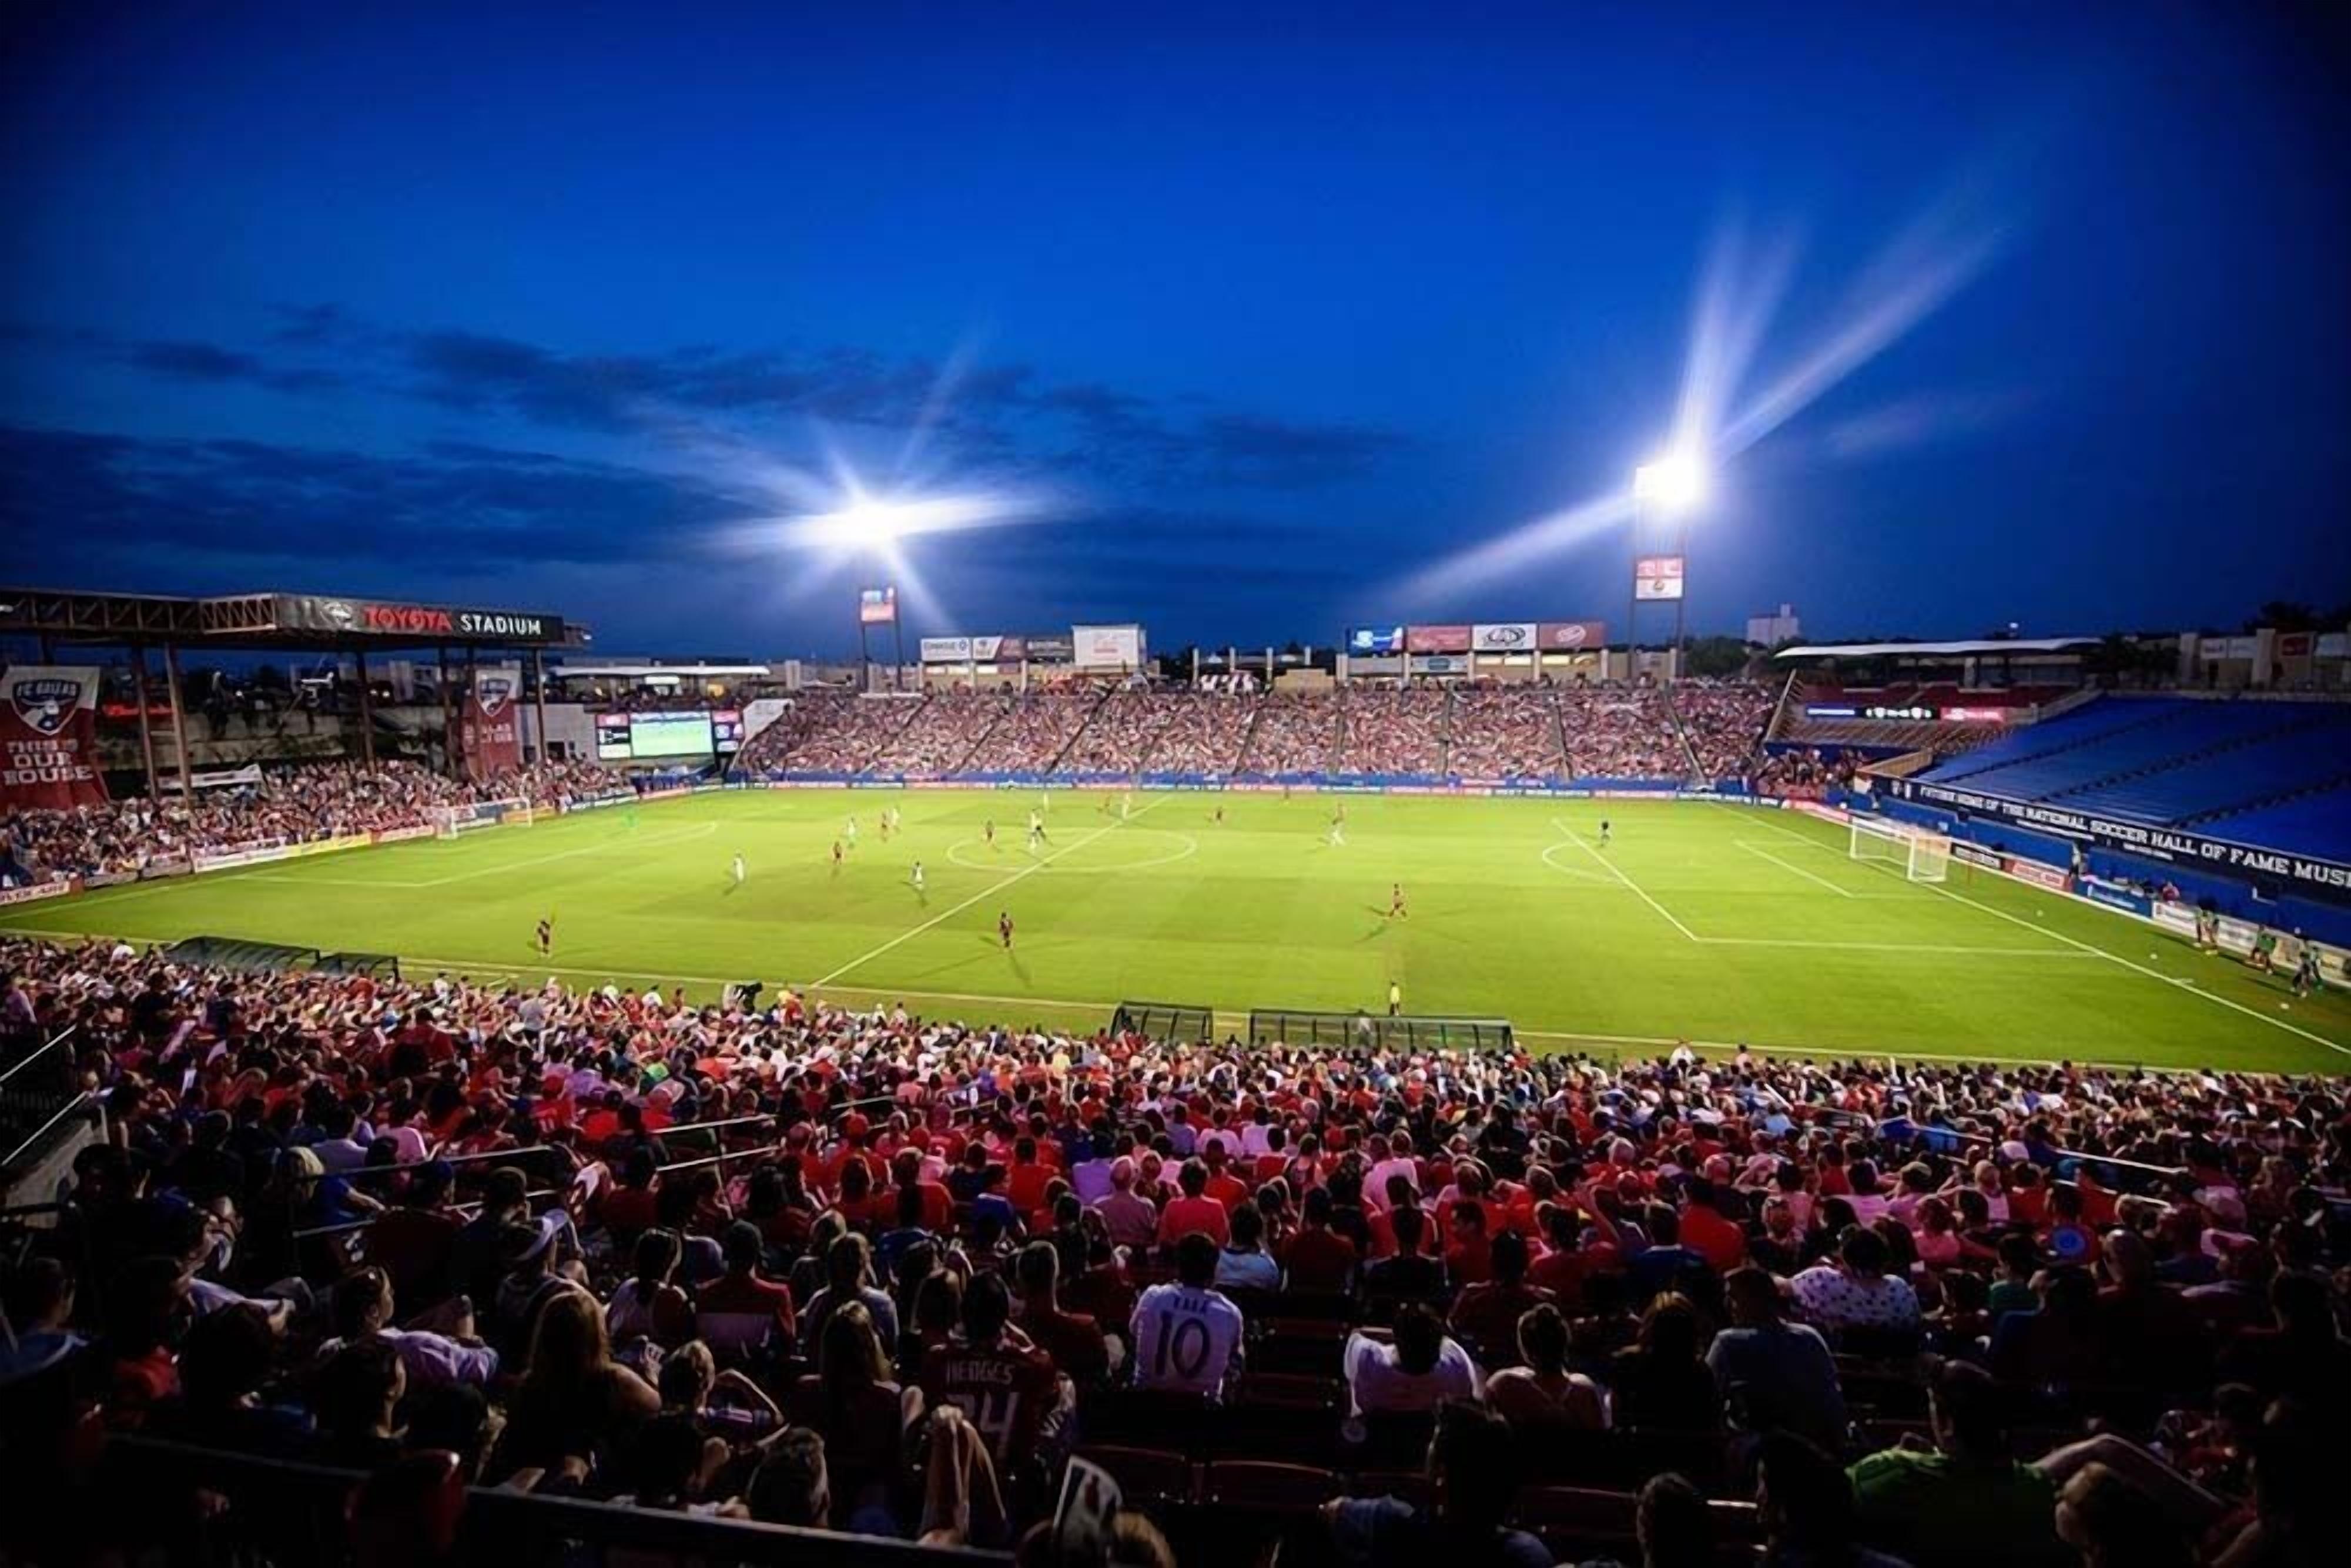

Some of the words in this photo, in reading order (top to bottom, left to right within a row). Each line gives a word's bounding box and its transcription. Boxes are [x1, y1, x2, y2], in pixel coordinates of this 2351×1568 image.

[364, 605, 453, 632] TOYOTA
[460, 614, 541, 635] STADIUM
[14, 752, 72, 769] OUR
[2090, 820, 2147, 844] SOCCER
[2151, 832, 2197, 855] HALL
[2201, 843, 2226, 860] OF
[2229, 848, 2289, 875] FAME
[1154, 1309, 1210, 1379] 10
